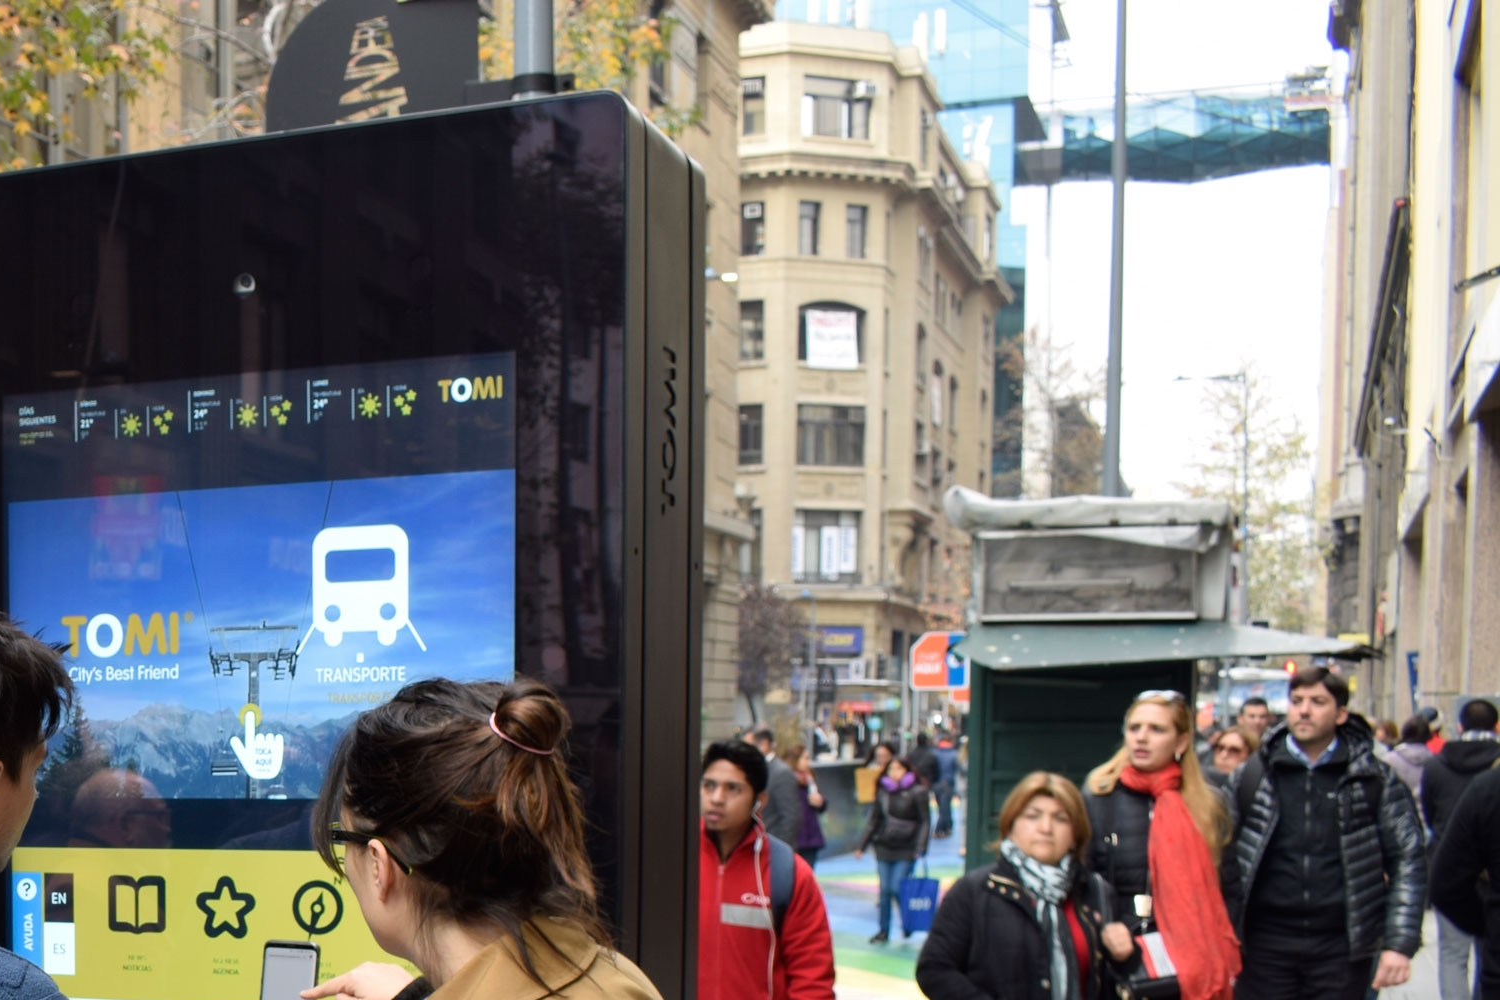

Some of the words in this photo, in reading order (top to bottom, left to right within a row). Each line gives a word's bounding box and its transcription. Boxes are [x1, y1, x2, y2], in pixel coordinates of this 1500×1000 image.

[438, 375, 503, 403] TOMI
[18, 414, 57, 427] SIGUIENTES
[61, 611, 179, 658] TOMI
[68, 663, 102, 685] City's
[105, 665, 134, 681] Best
[137, 663, 179, 681] Friend
[315, 665, 406, 683] TRANSPORTE
[51, 892, 67, 904] EN
[23, 913, 34, 951] AYUDA
[53, 943, 66, 955] ES
[212, 967, 240, 975] AGENDA
